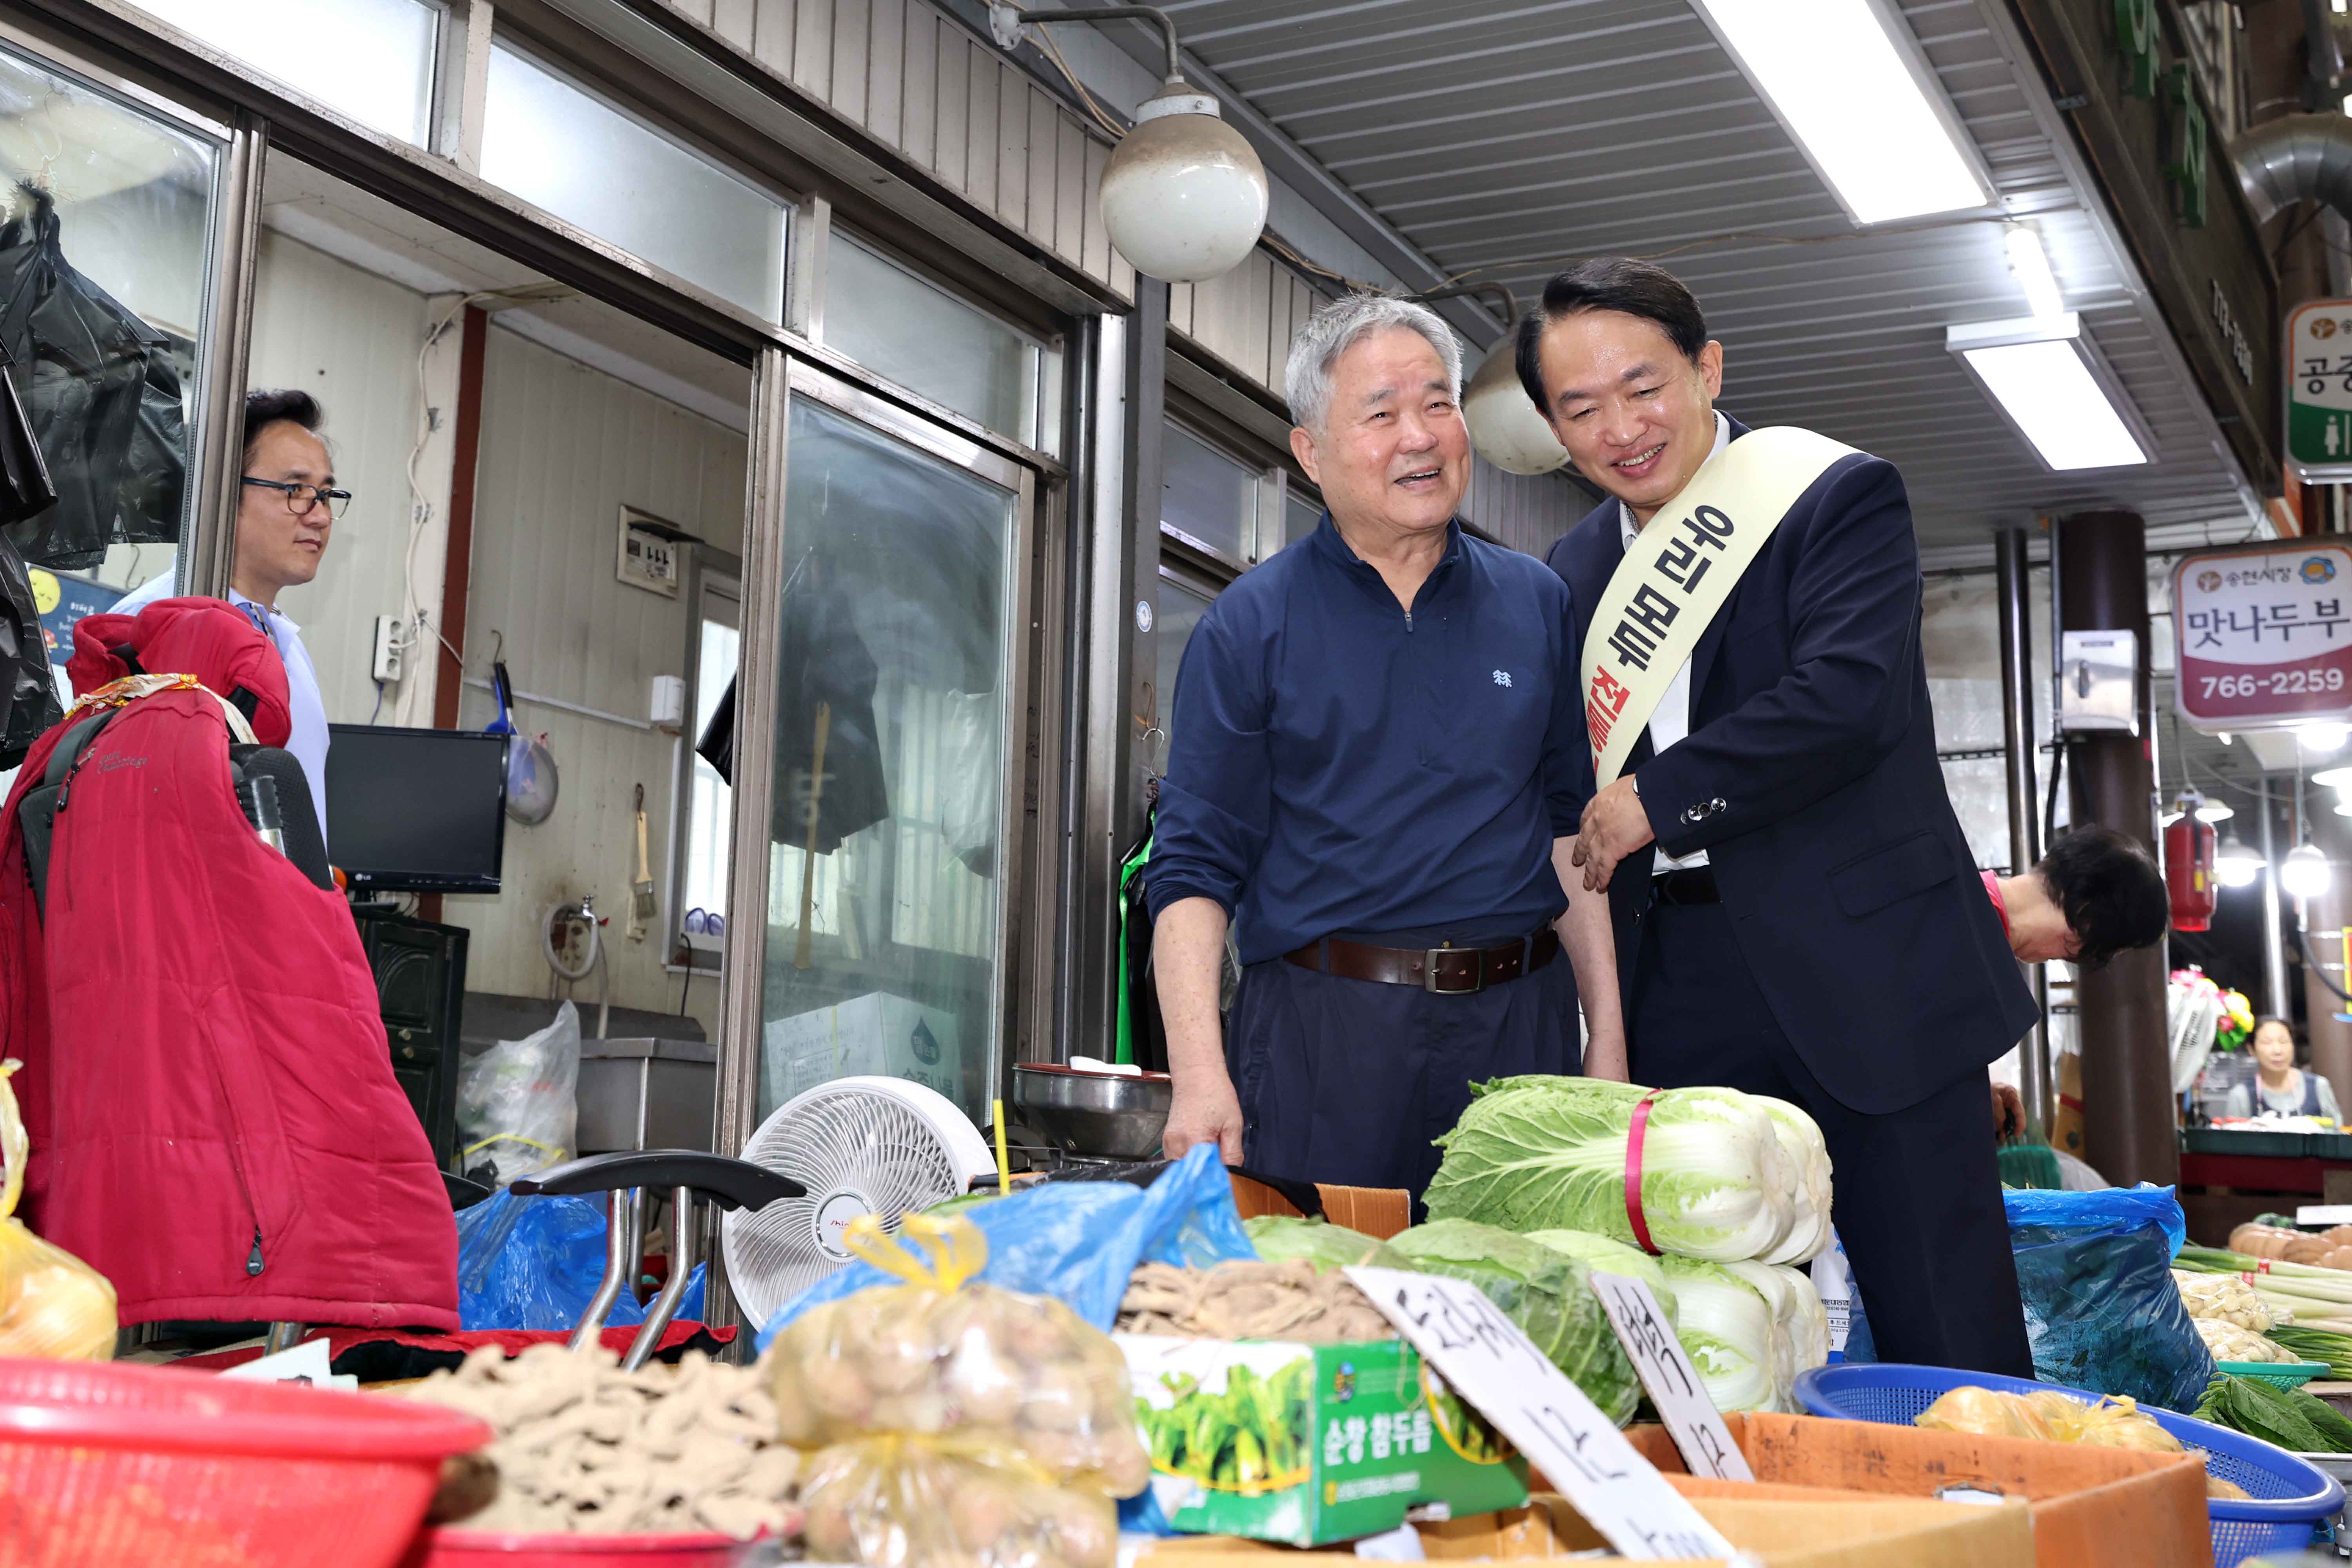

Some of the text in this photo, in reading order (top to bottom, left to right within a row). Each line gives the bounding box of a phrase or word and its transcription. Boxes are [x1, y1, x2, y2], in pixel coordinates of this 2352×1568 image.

[2225, 567, 2292, 588] 송현시장
[1586, 505, 1734, 779] 우리 모두 전통
[2187, 598, 2351, 649] 맛나두부
[2200, 667, 2345, 699] 766-2259
